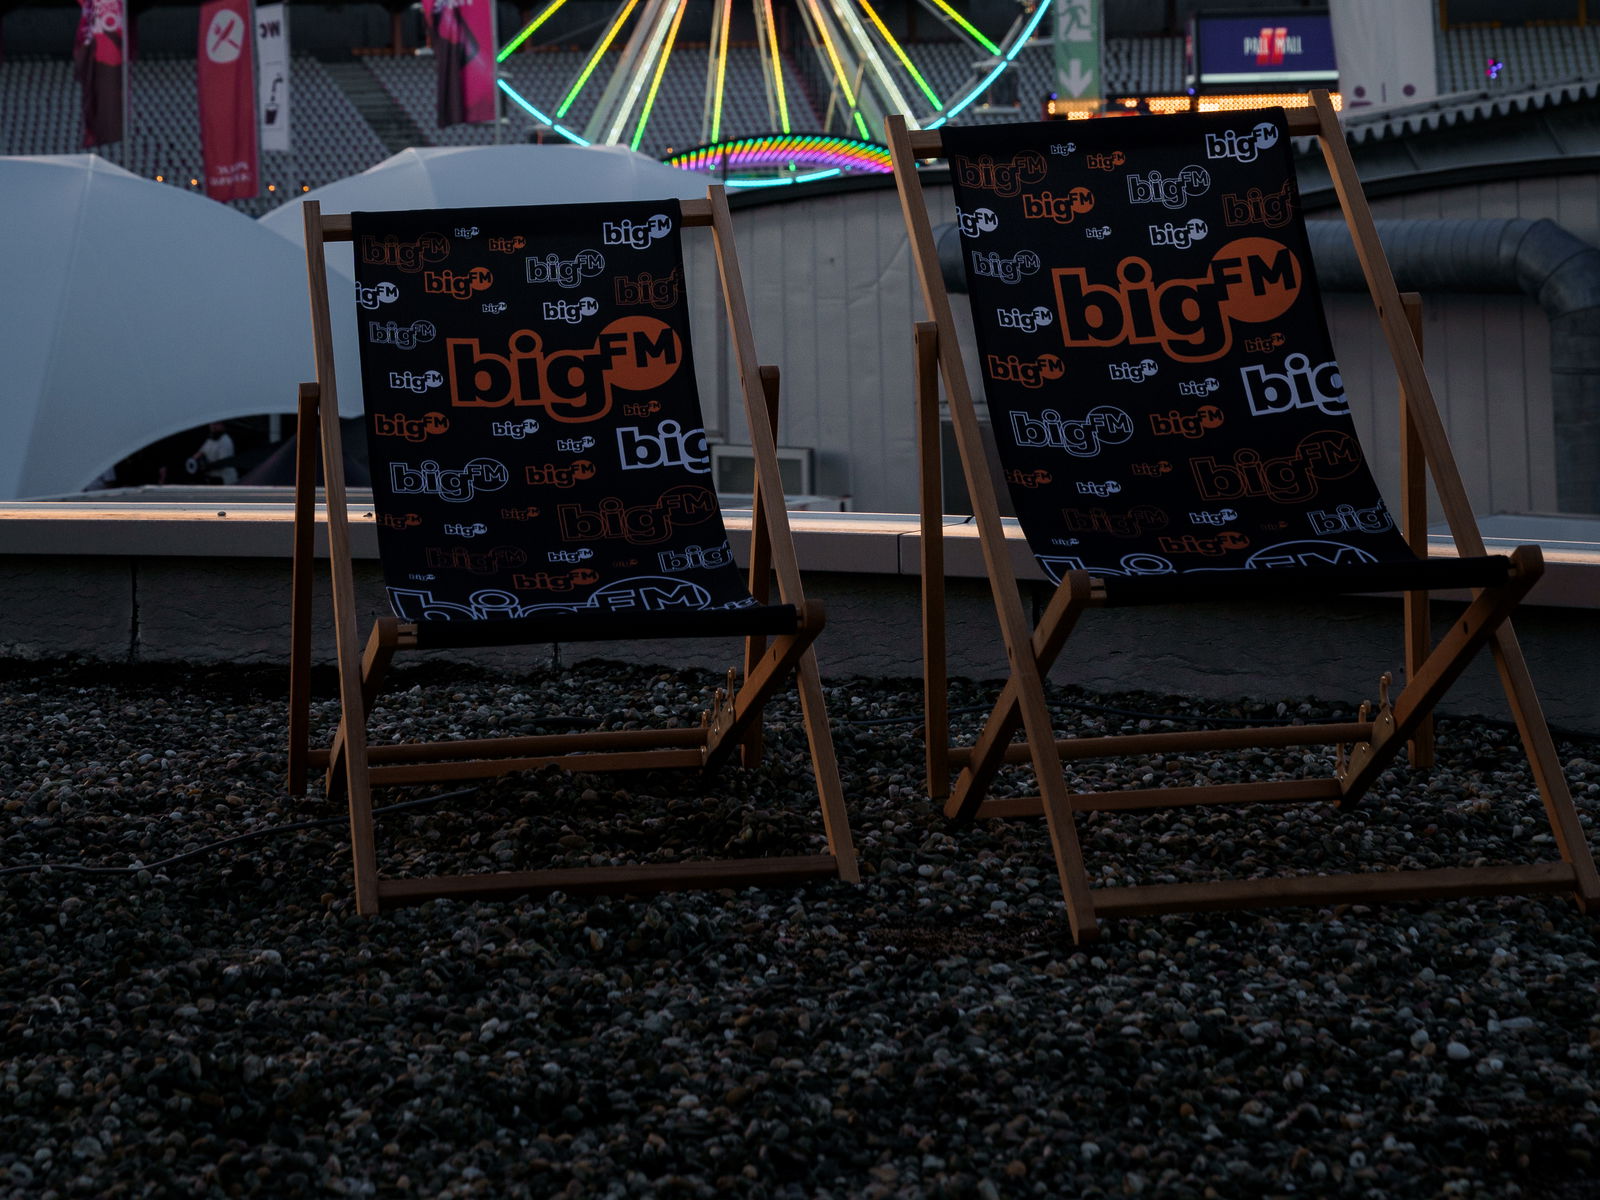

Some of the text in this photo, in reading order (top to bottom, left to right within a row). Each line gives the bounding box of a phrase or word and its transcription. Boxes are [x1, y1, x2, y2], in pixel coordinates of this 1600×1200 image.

[1205, 122, 1279, 163] bigFM
[956, 150, 1048, 198] bigFM
[1127, 165, 1210, 209] bigFM
[1022, 186, 1096, 225] bigFM
[603, 214, 672, 249] bigFM
[1149, 218, 1208, 249] bigFM
[362, 232, 450, 273] bigFM
[525, 249, 605, 288] bigFM
[972, 250, 1041, 284] bigFM
[424, 266, 494, 300] bigFM
[1051, 236, 1303, 363] bigFM
[543, 296, 599, 324] bigFM
[996, 306, 1054, 333] bigFM
[368, 319, 437, 350] bigFM
[389, 369, 443, 393] bigFM
[445, 315, 683, 423] bigFM
[987, 353, 1067, 389] bigFM
[1108, 359, 1159, 383] bigFM
[375, 411, 450, 443] bigFM
[492, 418, 539, 439] bigFM
[1009, 405, 1134, 457] bigFM
[1149, 405, 1225, 439] bigFM
[389, 457, 509, 503] bigFM
[525, 459, 597, 488] bigFM
[1189, 430, 1361, 504] bigFM
[556, 485, 719, 545] bigFM
[1306, 498, 1391, 536] big
[657, 539, 733, 573] big
[1157, 530, 1250, 556] bigFM
[513, 567, 599, 592] bigFM
